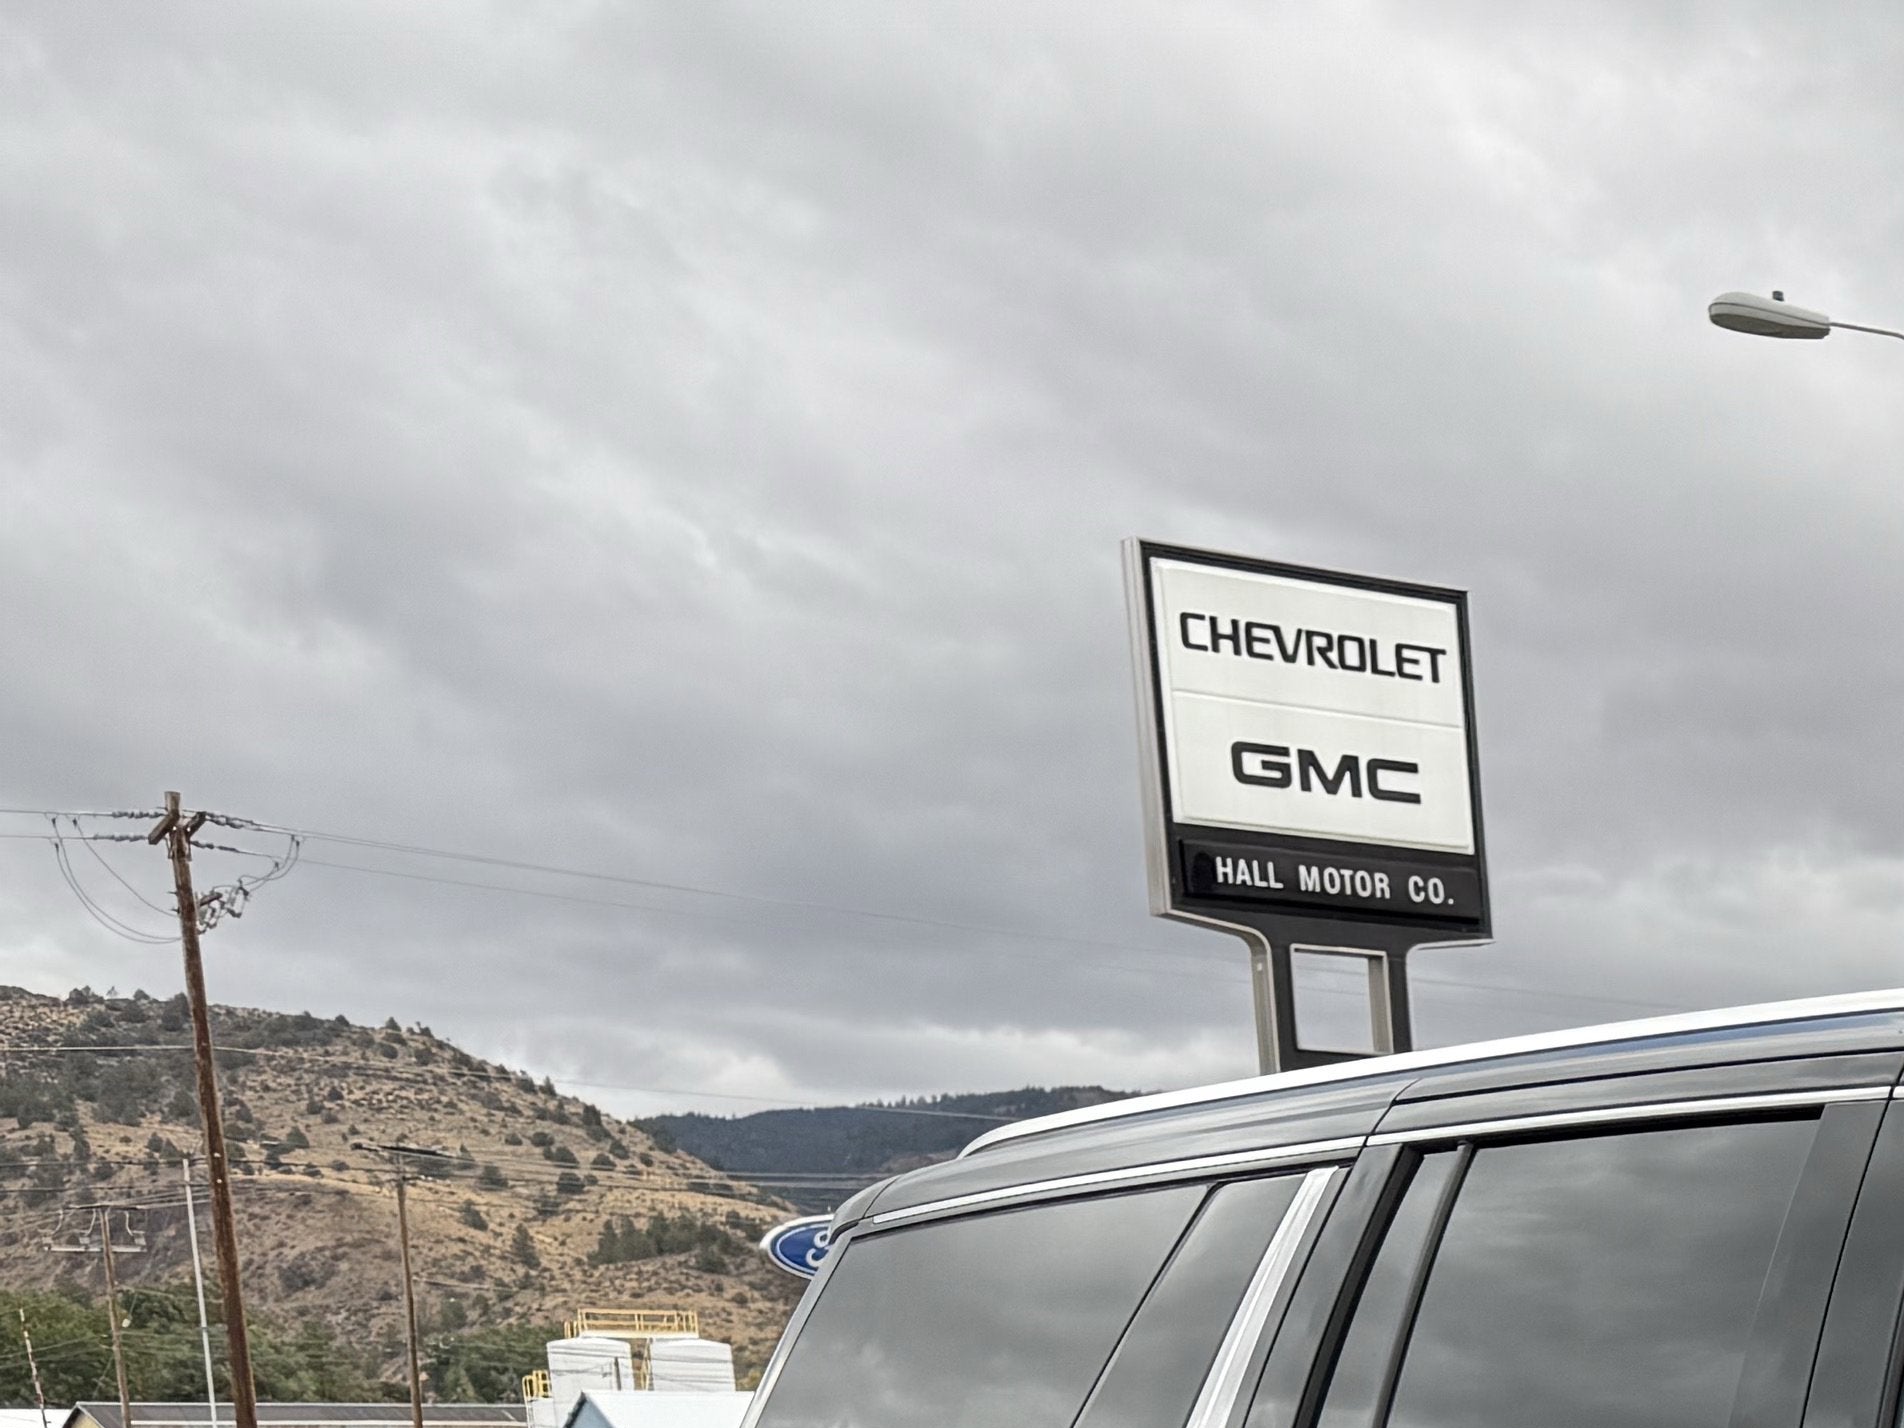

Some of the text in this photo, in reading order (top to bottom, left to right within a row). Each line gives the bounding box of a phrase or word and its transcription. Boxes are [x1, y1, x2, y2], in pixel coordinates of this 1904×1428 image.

[1179, 610, 1447, 684] CHEVROLET
[1230, 740, 1422, 805] GMC
[1215, 855, 1455, 906] HALL MOTOR CO.
